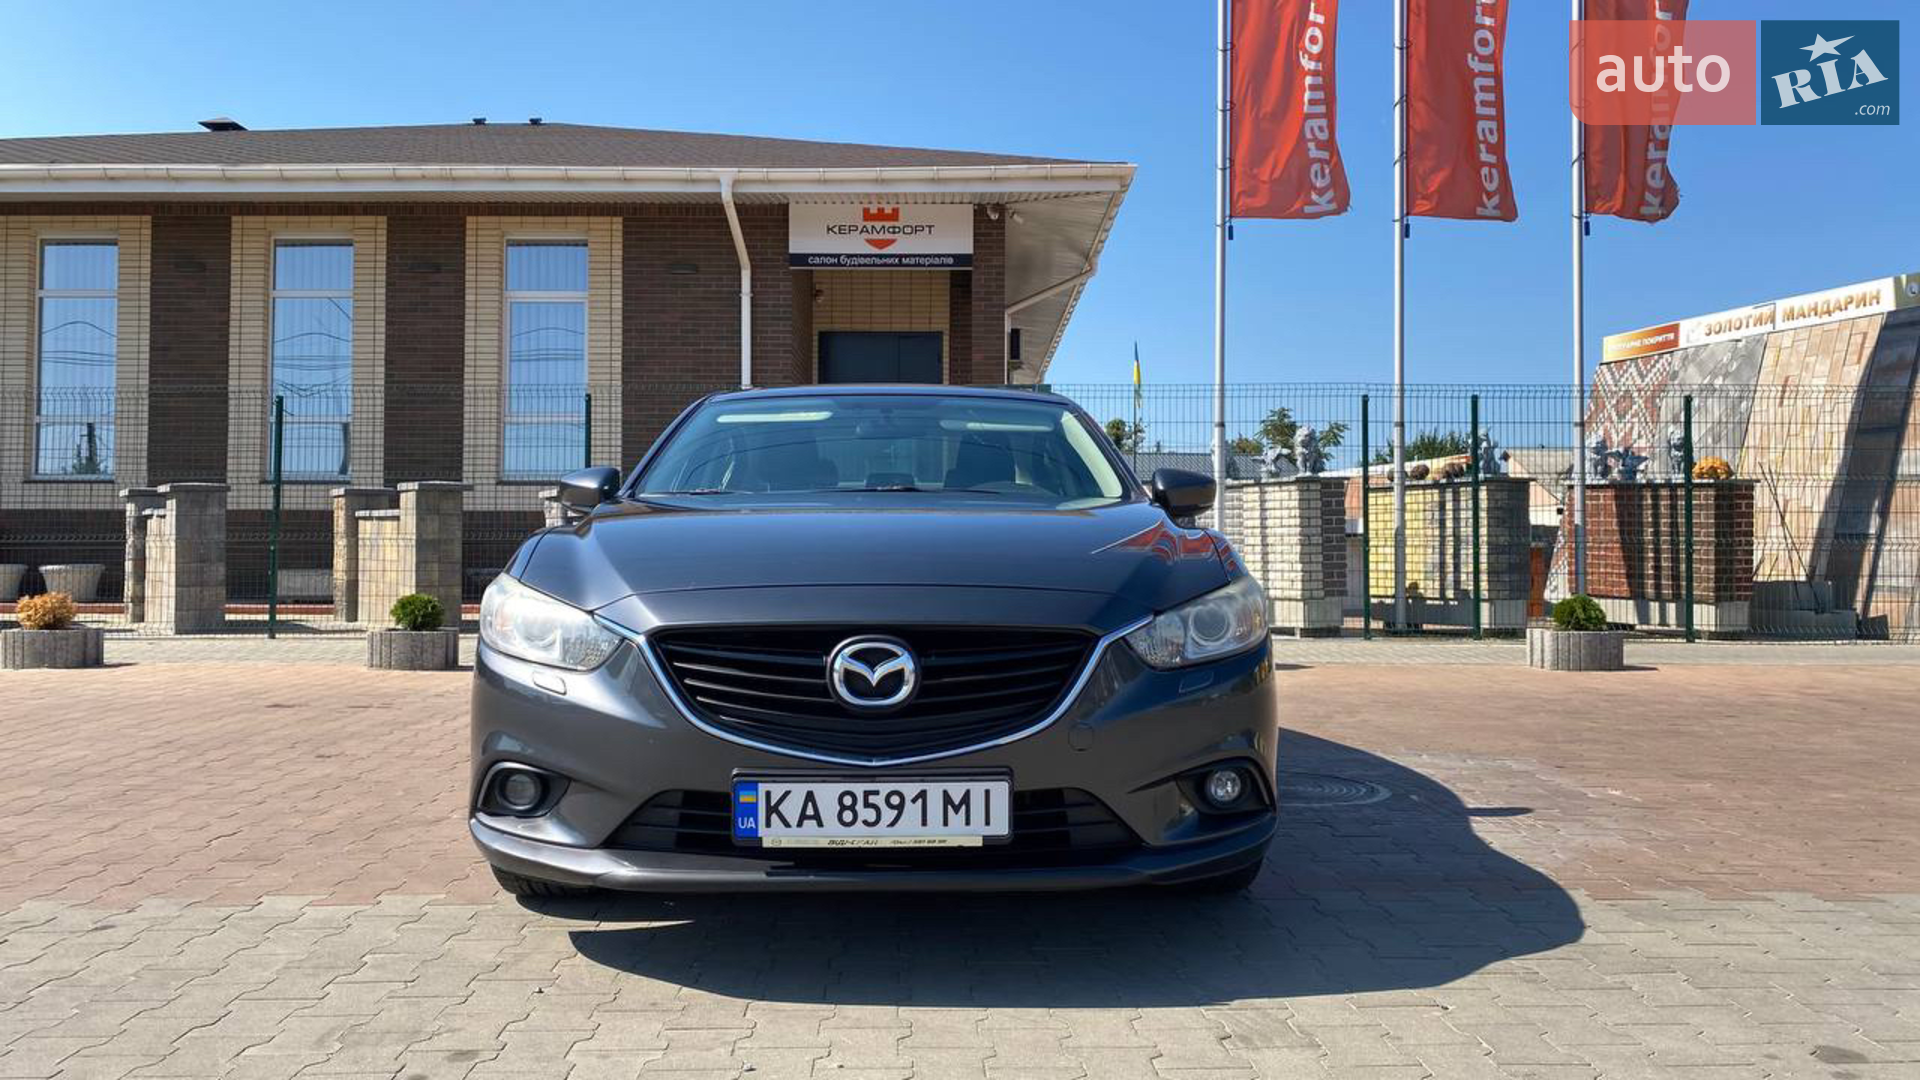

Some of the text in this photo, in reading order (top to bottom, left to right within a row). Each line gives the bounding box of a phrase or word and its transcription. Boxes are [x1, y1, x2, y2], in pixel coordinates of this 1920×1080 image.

[826, 224, 935, 235] КЕРАМФОРТ
[808, 255, 954, 268] салон будівельних матеріалів
[1704, 288, 1881, 337] ЗОЛОТИЙ МАНДАРИН
[738, 789, 991, 829] UA KA 8591 MI
